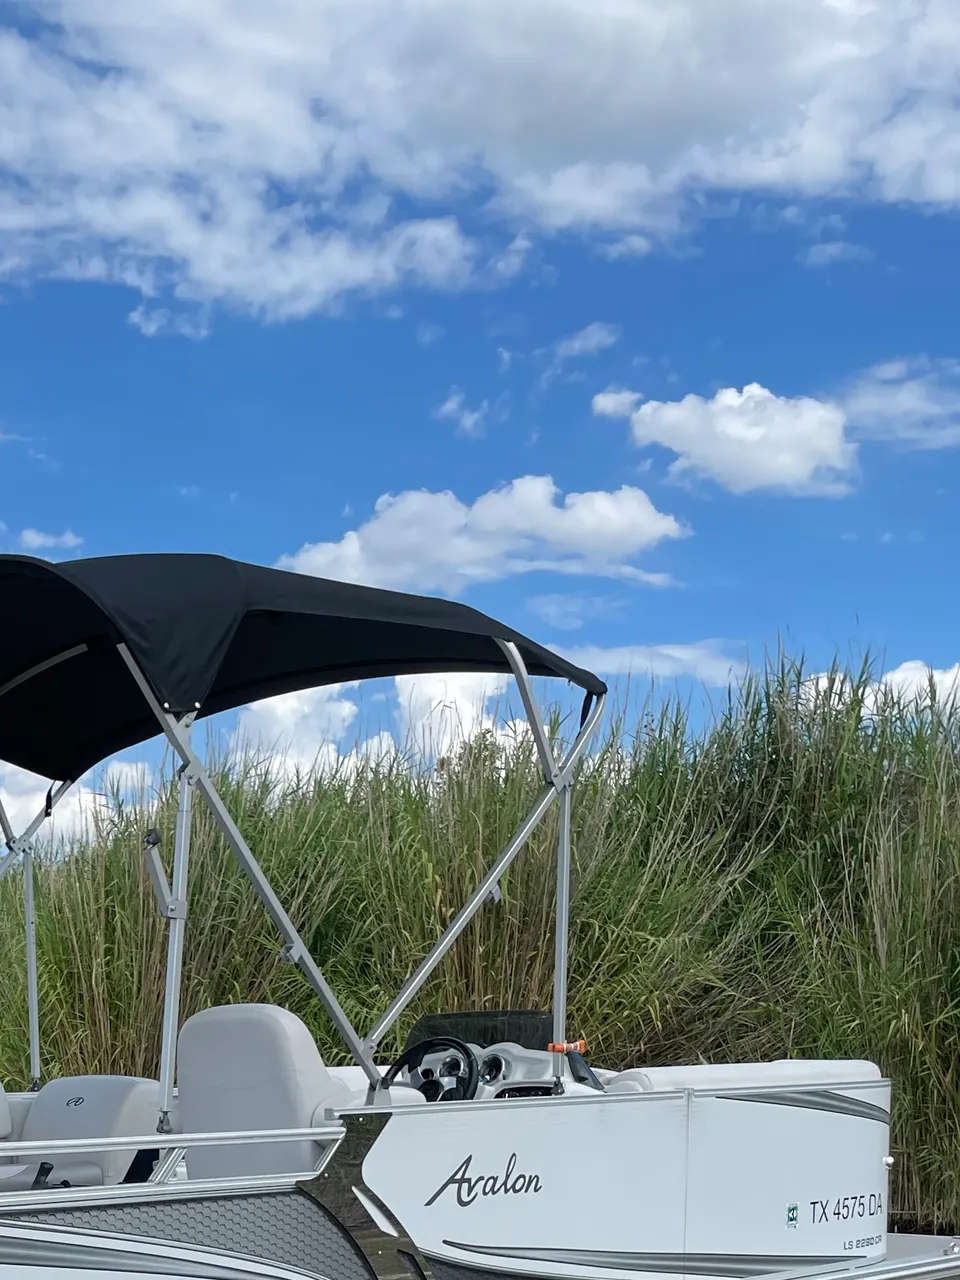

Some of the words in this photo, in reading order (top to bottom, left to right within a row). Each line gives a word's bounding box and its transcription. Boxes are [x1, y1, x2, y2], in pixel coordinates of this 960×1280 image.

[424, 1152, 542, 1207] Avalon
[810, 1200, 829, 1224] TX
[833, 1195, 865, 1221] 4575
[868, 1193, 882, 1216] DA
[843, 1241, 854, 1251] LS
